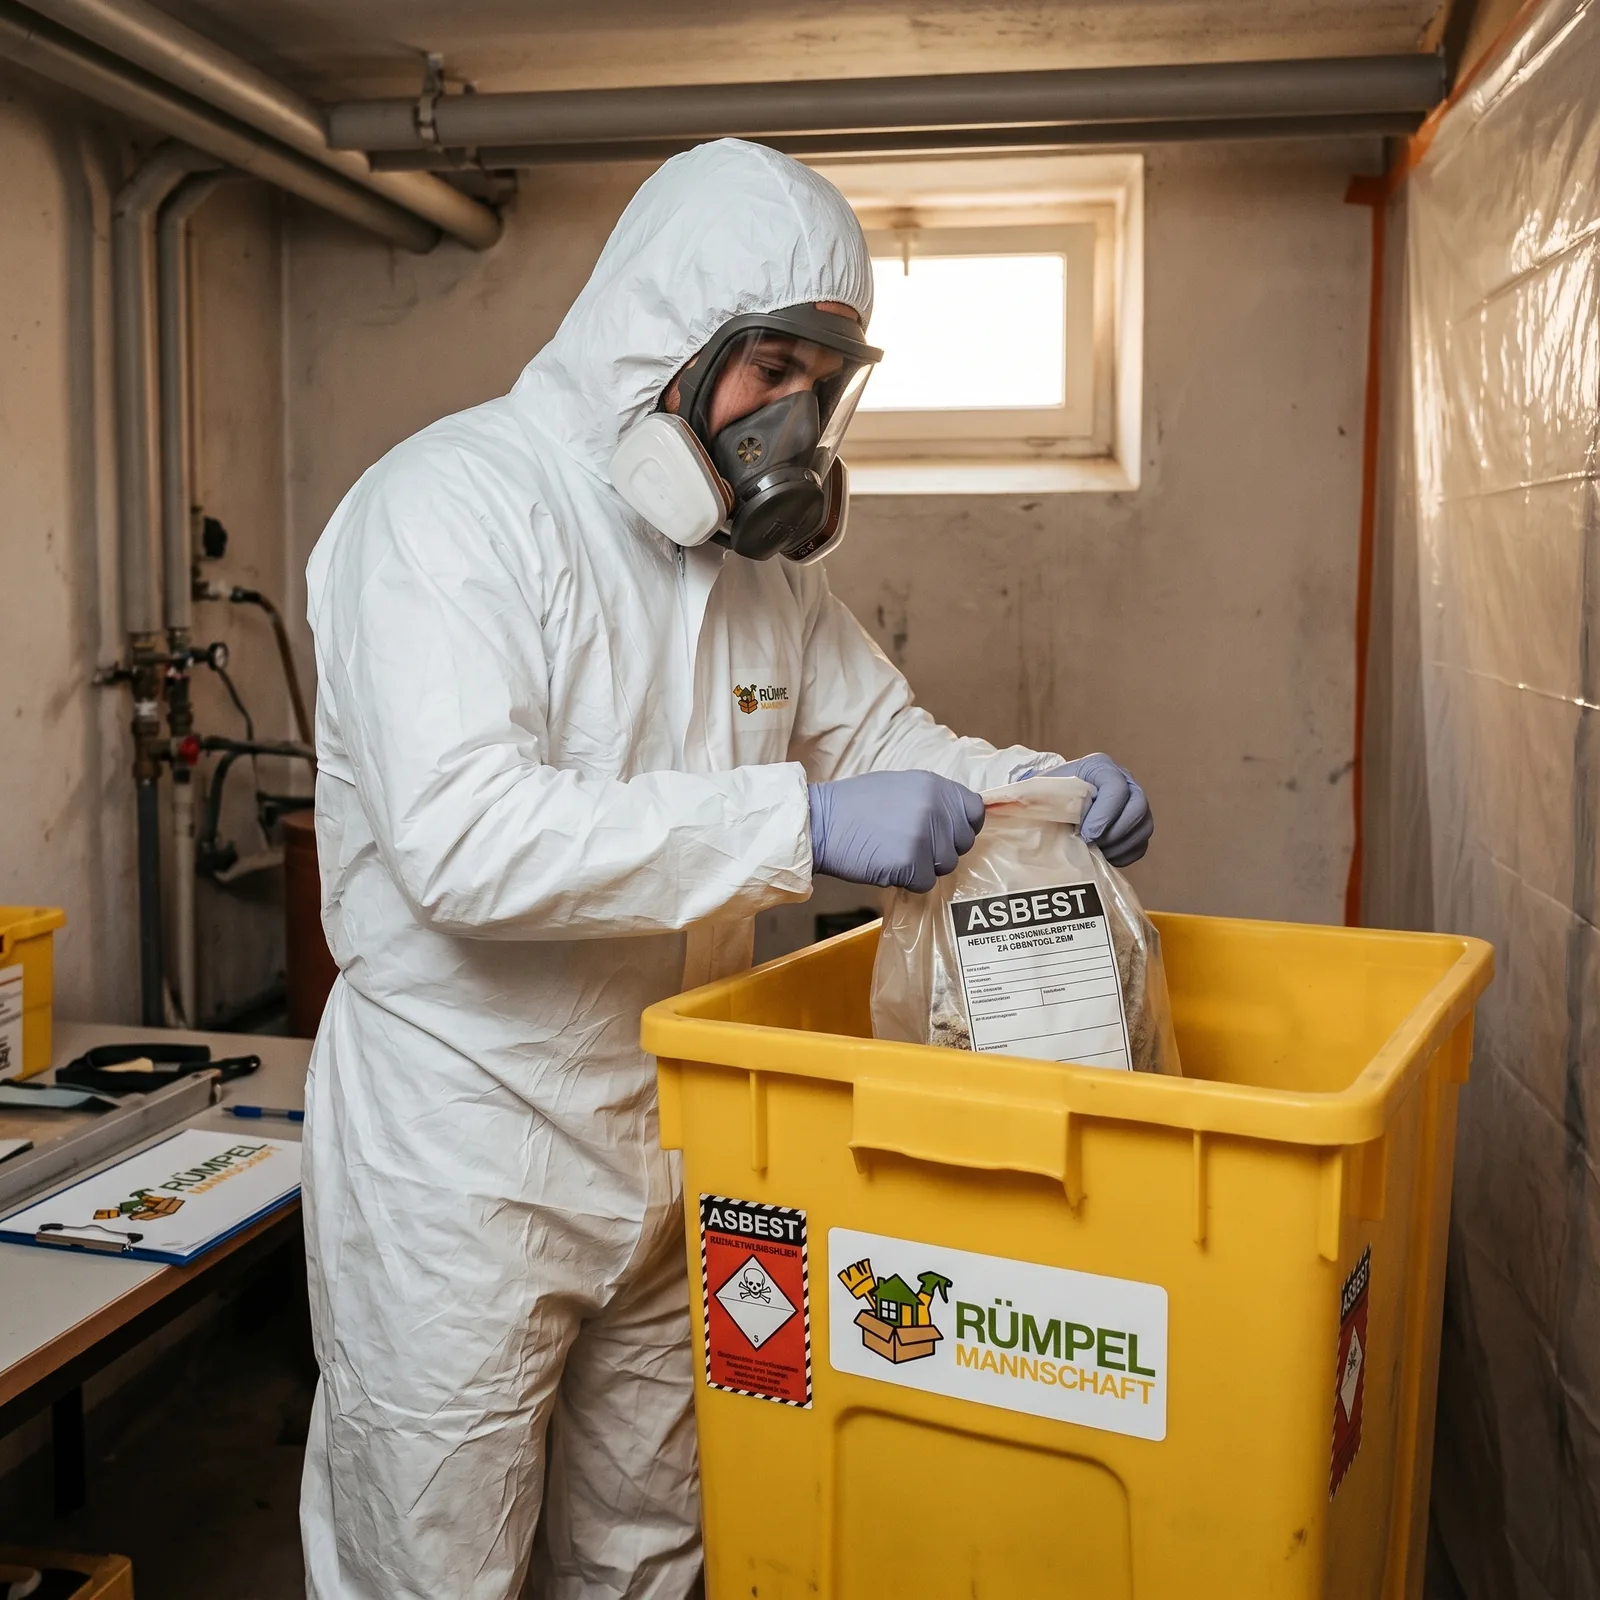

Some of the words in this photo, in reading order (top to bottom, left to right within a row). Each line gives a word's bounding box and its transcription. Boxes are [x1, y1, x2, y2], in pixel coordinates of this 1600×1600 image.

[967, 889, 1087, 931] ASBEST
[158, 1144, 267, 1192] RÜMPEL
[707, 1207, 799, 1240] ASBEST
[956, 1298, 1156, 1378] RÜMPEL
[956, 1343, 1155, 1405] MANNSCHAFT
